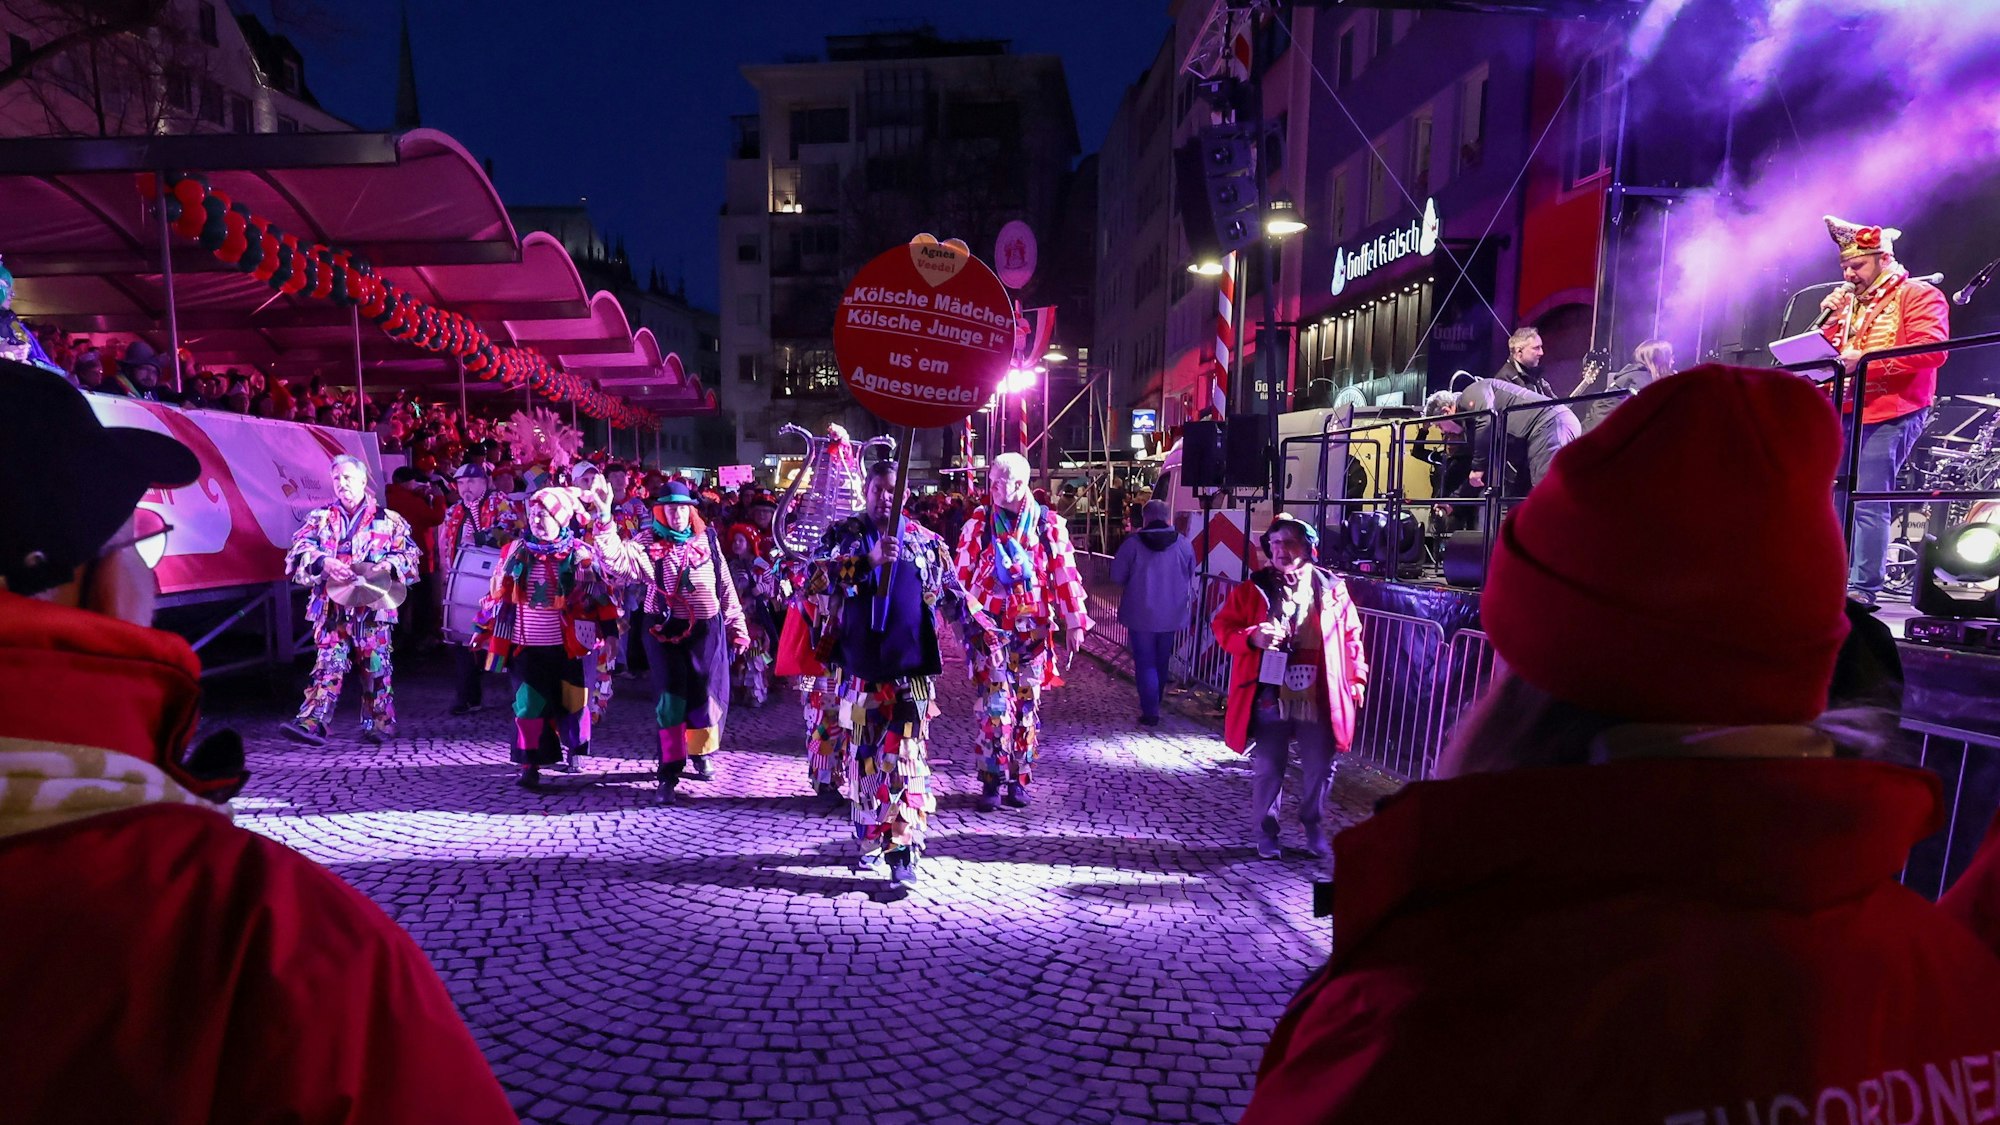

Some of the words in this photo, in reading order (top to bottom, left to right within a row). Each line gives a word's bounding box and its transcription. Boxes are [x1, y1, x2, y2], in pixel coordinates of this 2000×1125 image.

[920, 246, 956, 259] Agnes
[1347, 239, 1378, 281] Gaffel
[1379, 219, 1420, 266] Kölsch
[917, 258, 956, 274] Veedel
[934, 294, 1014, 329] Mädcher
[847, 308, 922, 332] Kölsche
[927, 319, 984, 347] Junge
[889, 351, 913, 369] us
[918, 358, 950, 374] em
[851, 366, 980, 403] Agnesveedel
[1254, 380, 1286, 393] Gael
